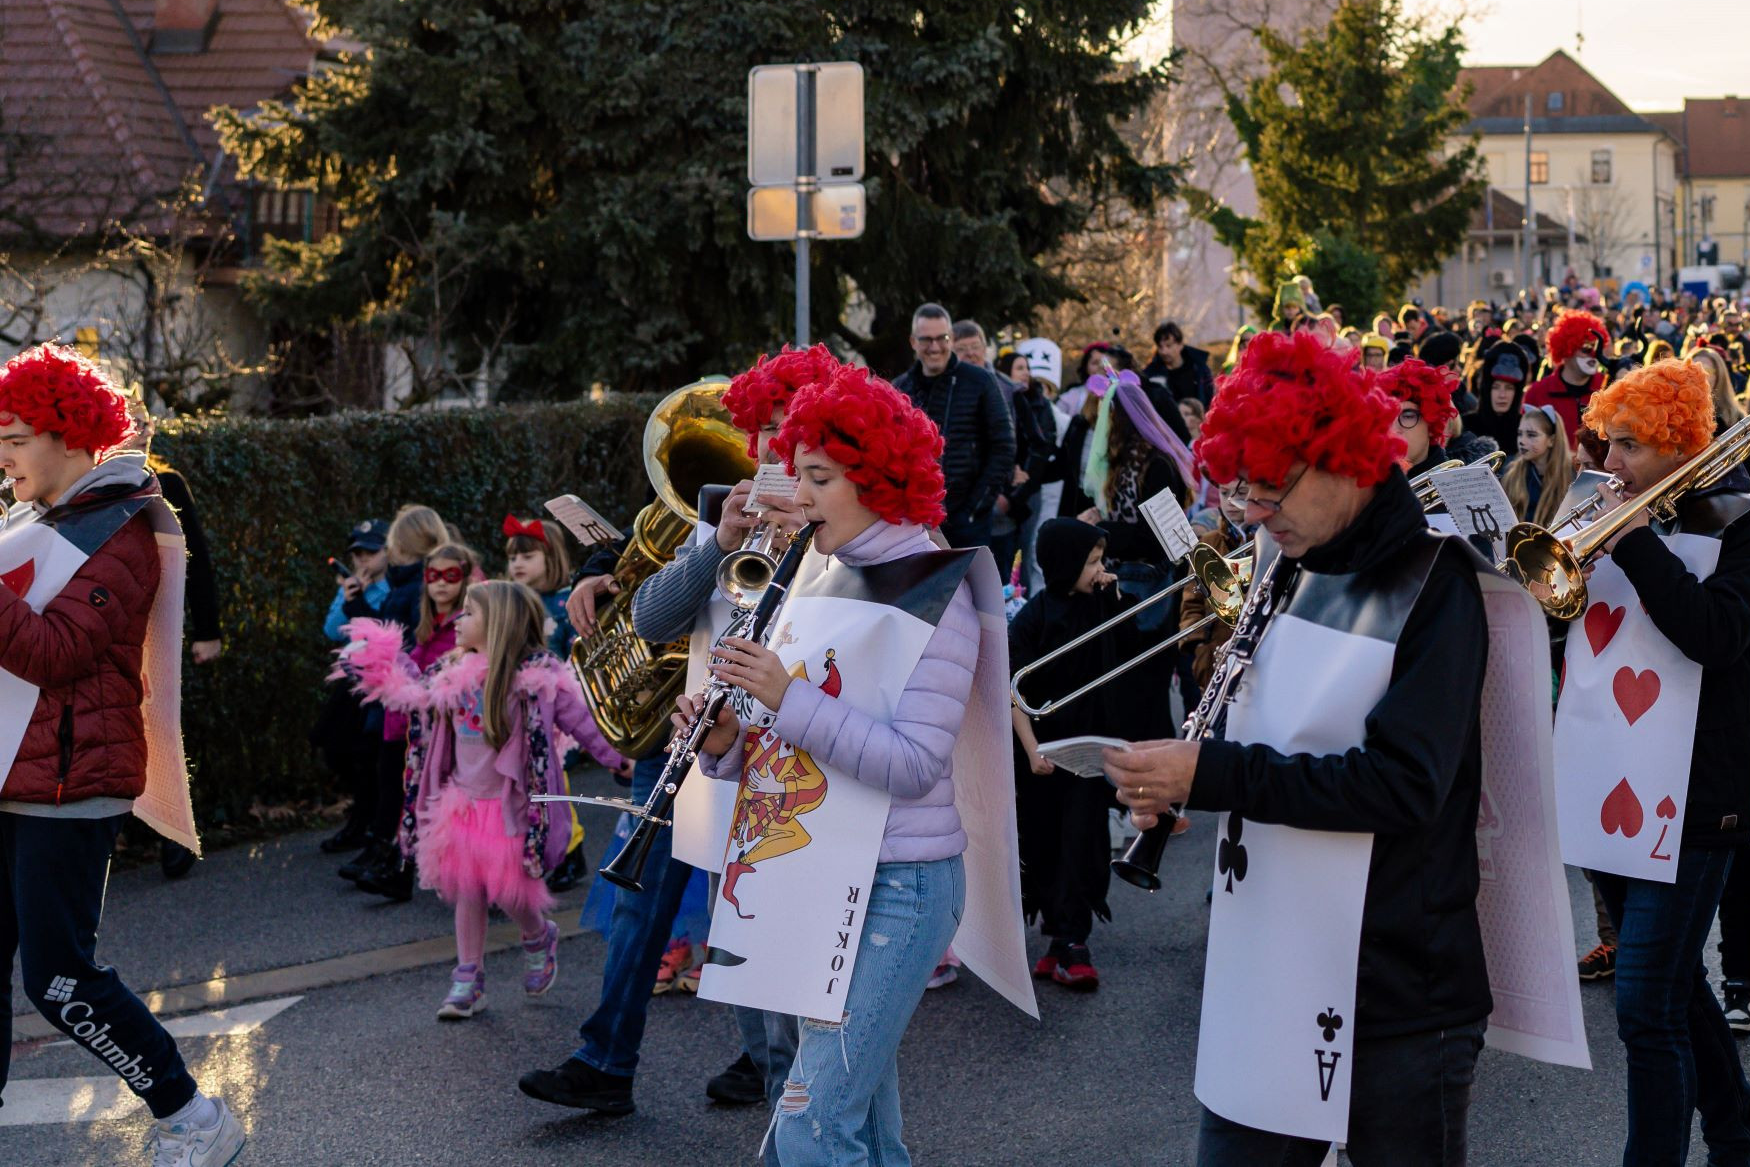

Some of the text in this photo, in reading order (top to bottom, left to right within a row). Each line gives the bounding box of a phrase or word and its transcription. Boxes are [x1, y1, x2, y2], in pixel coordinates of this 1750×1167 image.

[1649, 824, 1671, 861] 7
[826, 885, 861, 995] JOKER
[60, 1001, 153, 1090] Columbia
[1314, 1048, 1342, 1102] A
